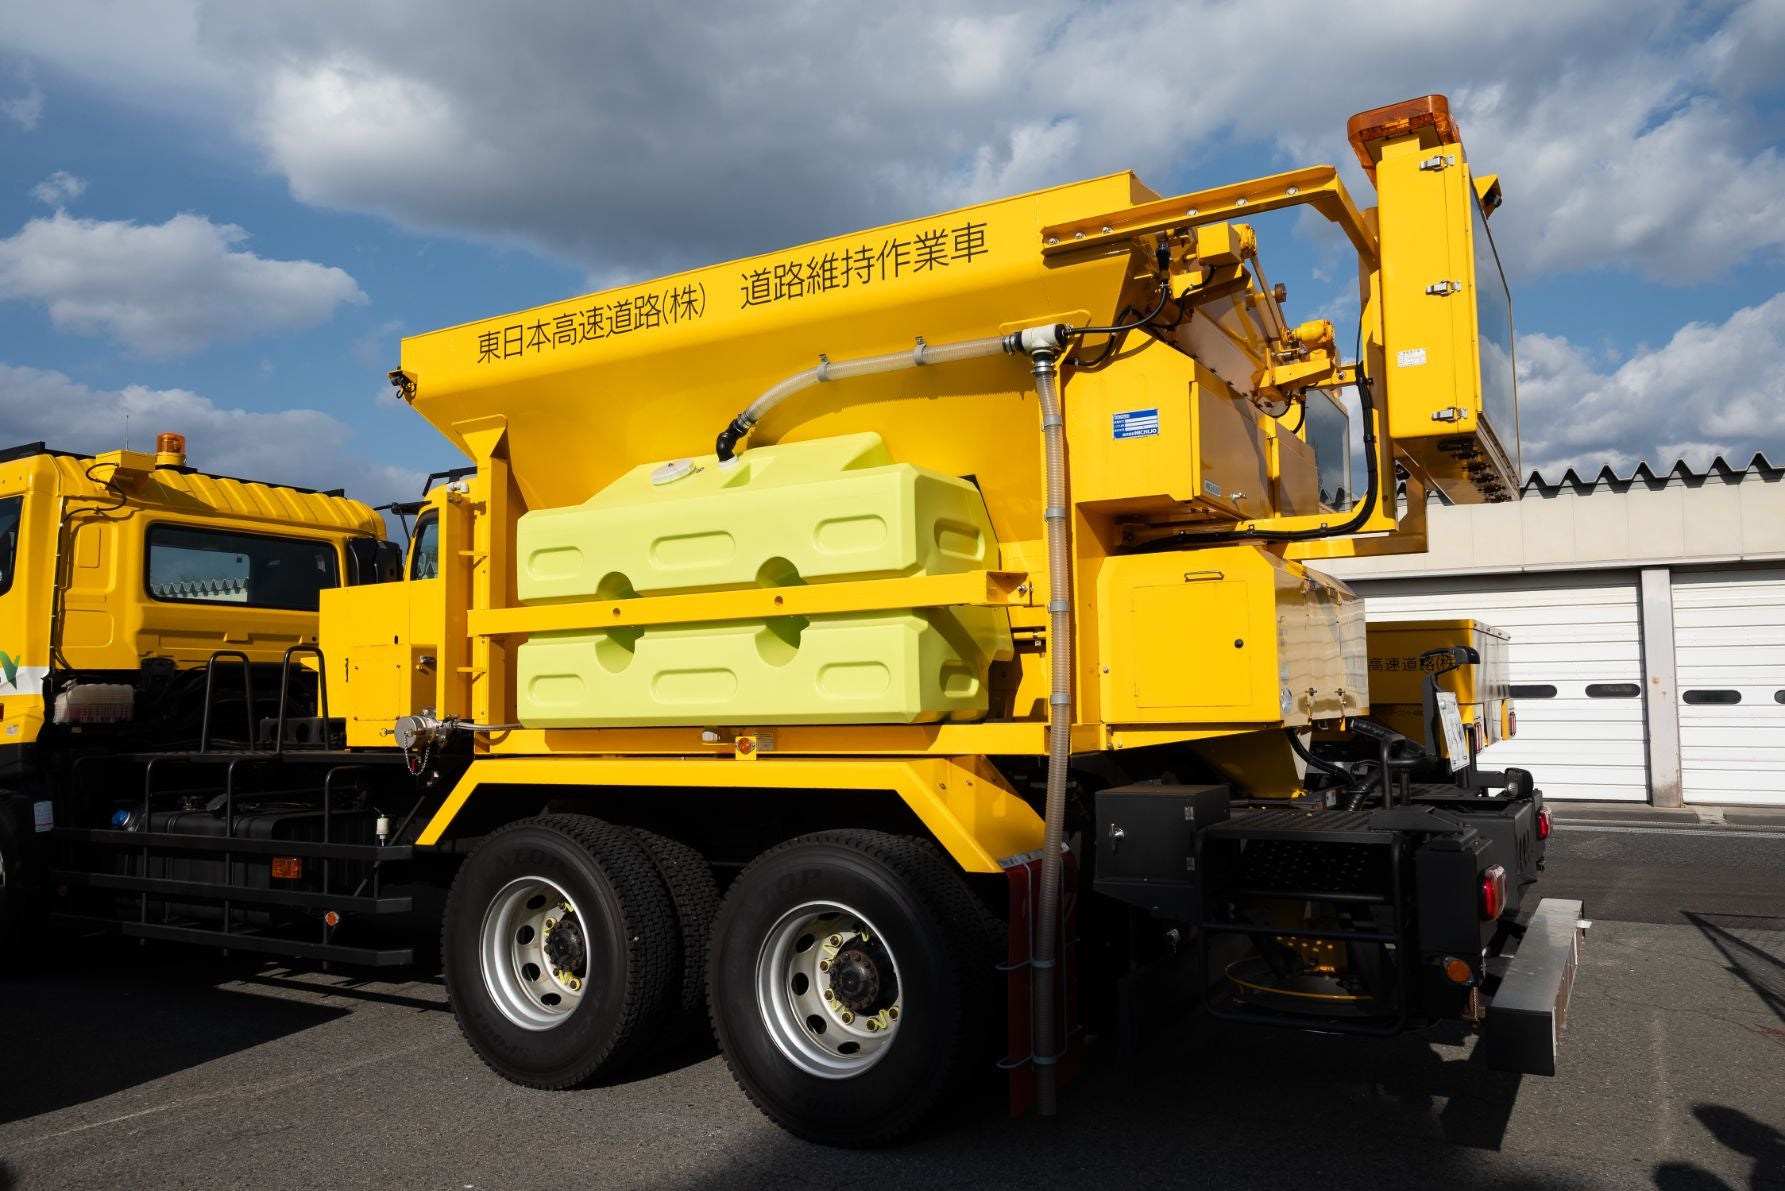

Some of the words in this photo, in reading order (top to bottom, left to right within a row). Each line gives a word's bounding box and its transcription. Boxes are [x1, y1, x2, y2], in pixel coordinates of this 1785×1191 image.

[477, 282, 706, 364] 東日本高速道路(株)
[740, 221, 989, 310] 道路維持作業車
